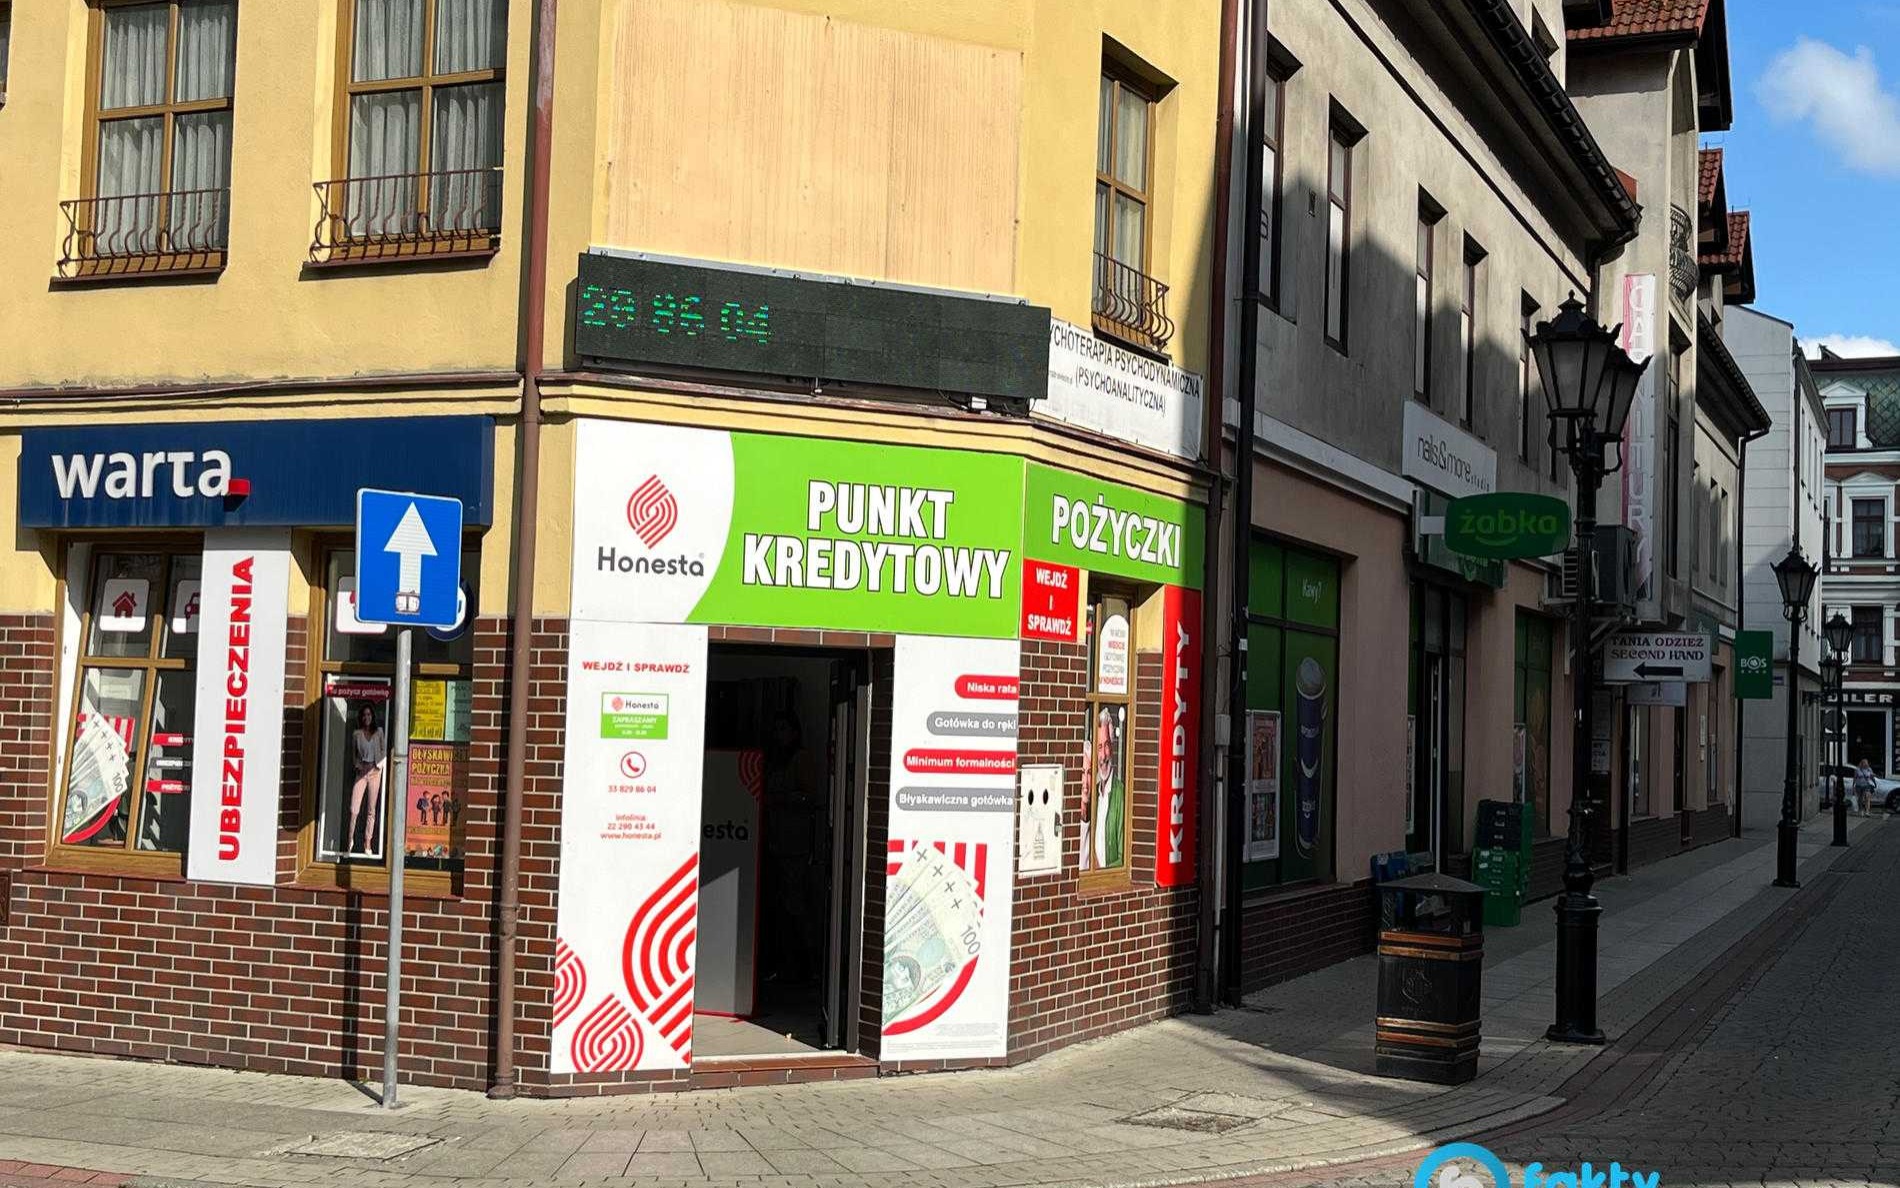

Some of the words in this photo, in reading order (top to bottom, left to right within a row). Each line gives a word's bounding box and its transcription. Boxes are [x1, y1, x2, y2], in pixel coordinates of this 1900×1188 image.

[720, 302, 771, 343] 04
[1114, 348, 1200, 398] PSYCHODYNAMICZNA
[1076, 365, 1166, 417] (PSYCHOANALITYCZNA)
[806, 480, 954, 539] PUNKT
[1051, 493, 1181, 569] POŻYCZKI
[1458, 509, 1560, 535] żabka
[598, 546, 704, 577] Honesta
[742, 532, 1011, 599] KREDYTOWY
[1035, 567, 1068, 589] WEJDŹ
[1048, 595, 1053, 611] I
[1027, 613, 1072, 636] SPRAWDŹ
[1612, 636, 1650, 647] TANIA
[1610, 649, 1666, 660] SECOND
[1669, 649, 1704, 661] HAND
[626, 662, 630, 672] I
[967, 682, 995, 694] Niska
[998, 683, 1017, 694] rata
[218, 556, 255, 862] UBEZPIECZENIA
[625, 700, 660, 710] Honesta
[934, 717, 980, 730] Gotówka
[981, 719, 995, 730] do
[1169, 619, 1190, 864] KREDYTY
[906, 756, 953, 767] Minimum
[955, 756, 1016, 769] formalności
[112, 772, 124, 794] 100
[899, 793, 969, 807] Błyskawiczna
[970, 794, 1014, 808] gotówka
[959, 925, 982, 956] 100
